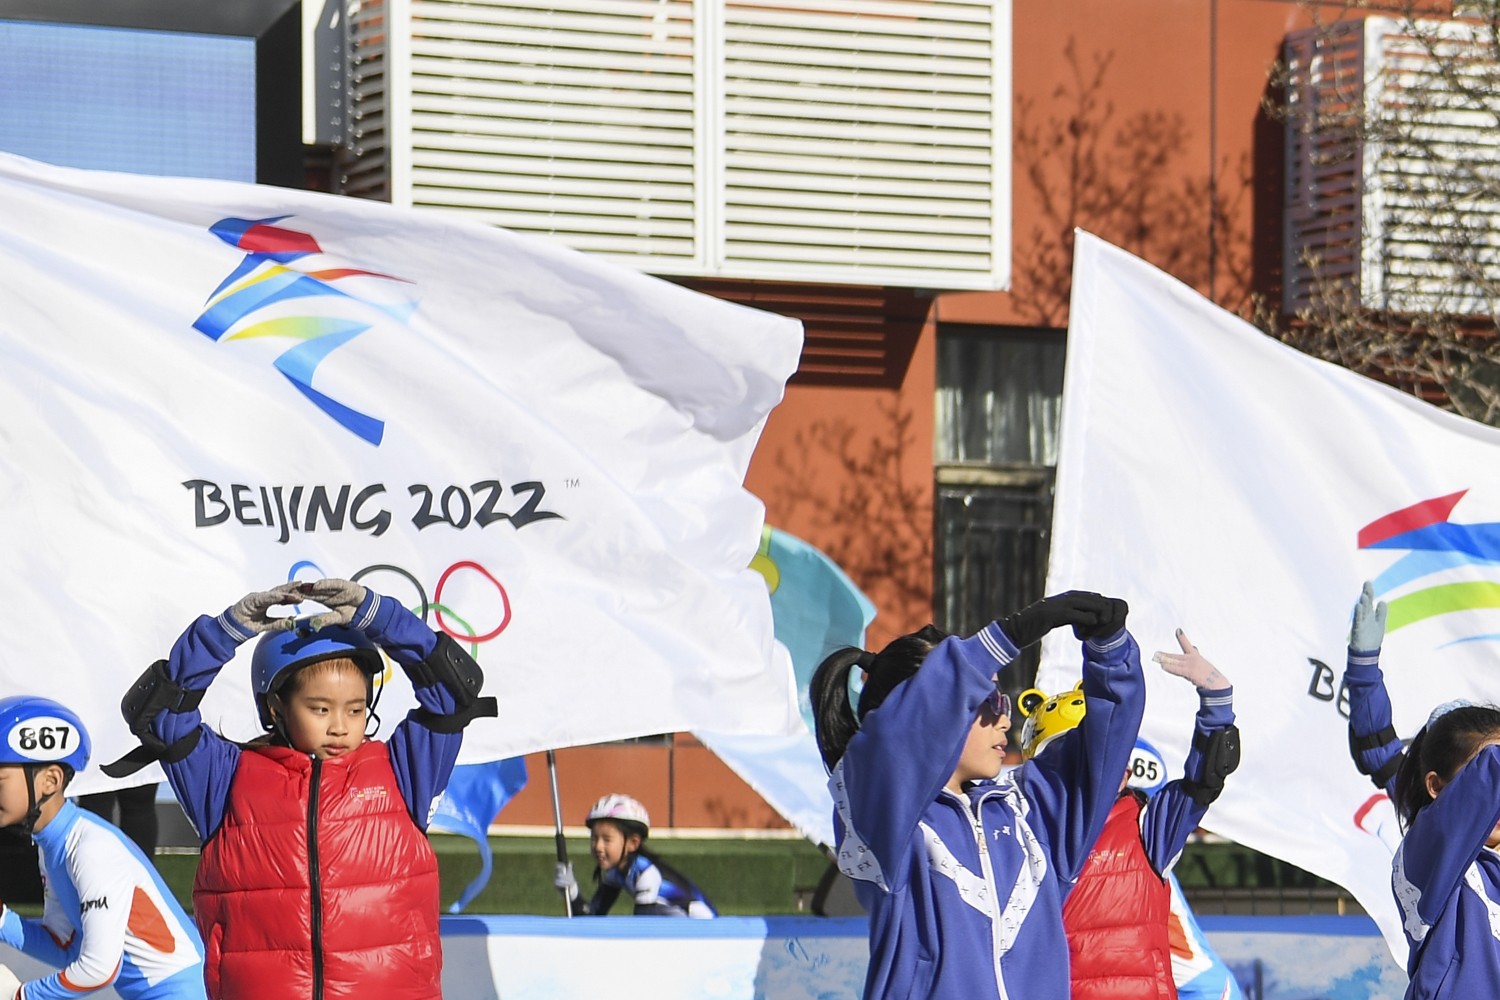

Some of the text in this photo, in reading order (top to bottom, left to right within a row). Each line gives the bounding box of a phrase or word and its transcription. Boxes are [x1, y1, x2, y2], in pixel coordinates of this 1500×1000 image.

[181, 479, 392, 544] BEIJING
[407, 479, 568, 531] 2022
[18, 726, 70, 750] 867
